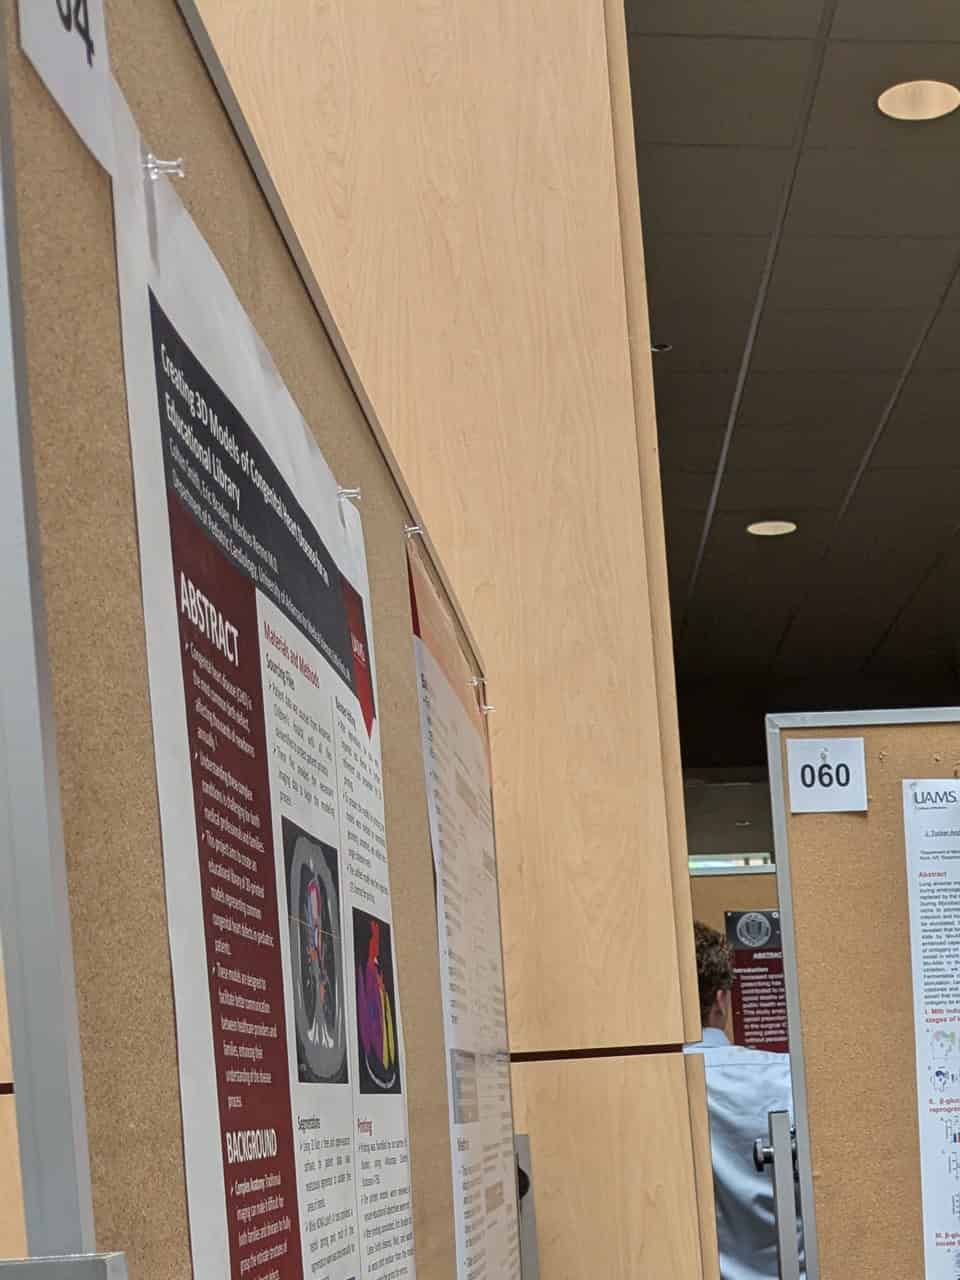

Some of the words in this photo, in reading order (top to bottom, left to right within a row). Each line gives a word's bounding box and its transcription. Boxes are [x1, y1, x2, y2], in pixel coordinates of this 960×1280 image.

[161, 344, 196, 418] Creating
[195, 390, 209, 423] 3D
[209, 408, 241, 465] Models
[165, 391, 211, 475] Educational
[212, 454, 240, 509] Library
[181, 572, 239, 667] ABSTRACT
[801, 762, 851, 789] 060
[913, 790, 957, 805] UAMS
[226, 1127, 277, 1163] BACKGROUND
